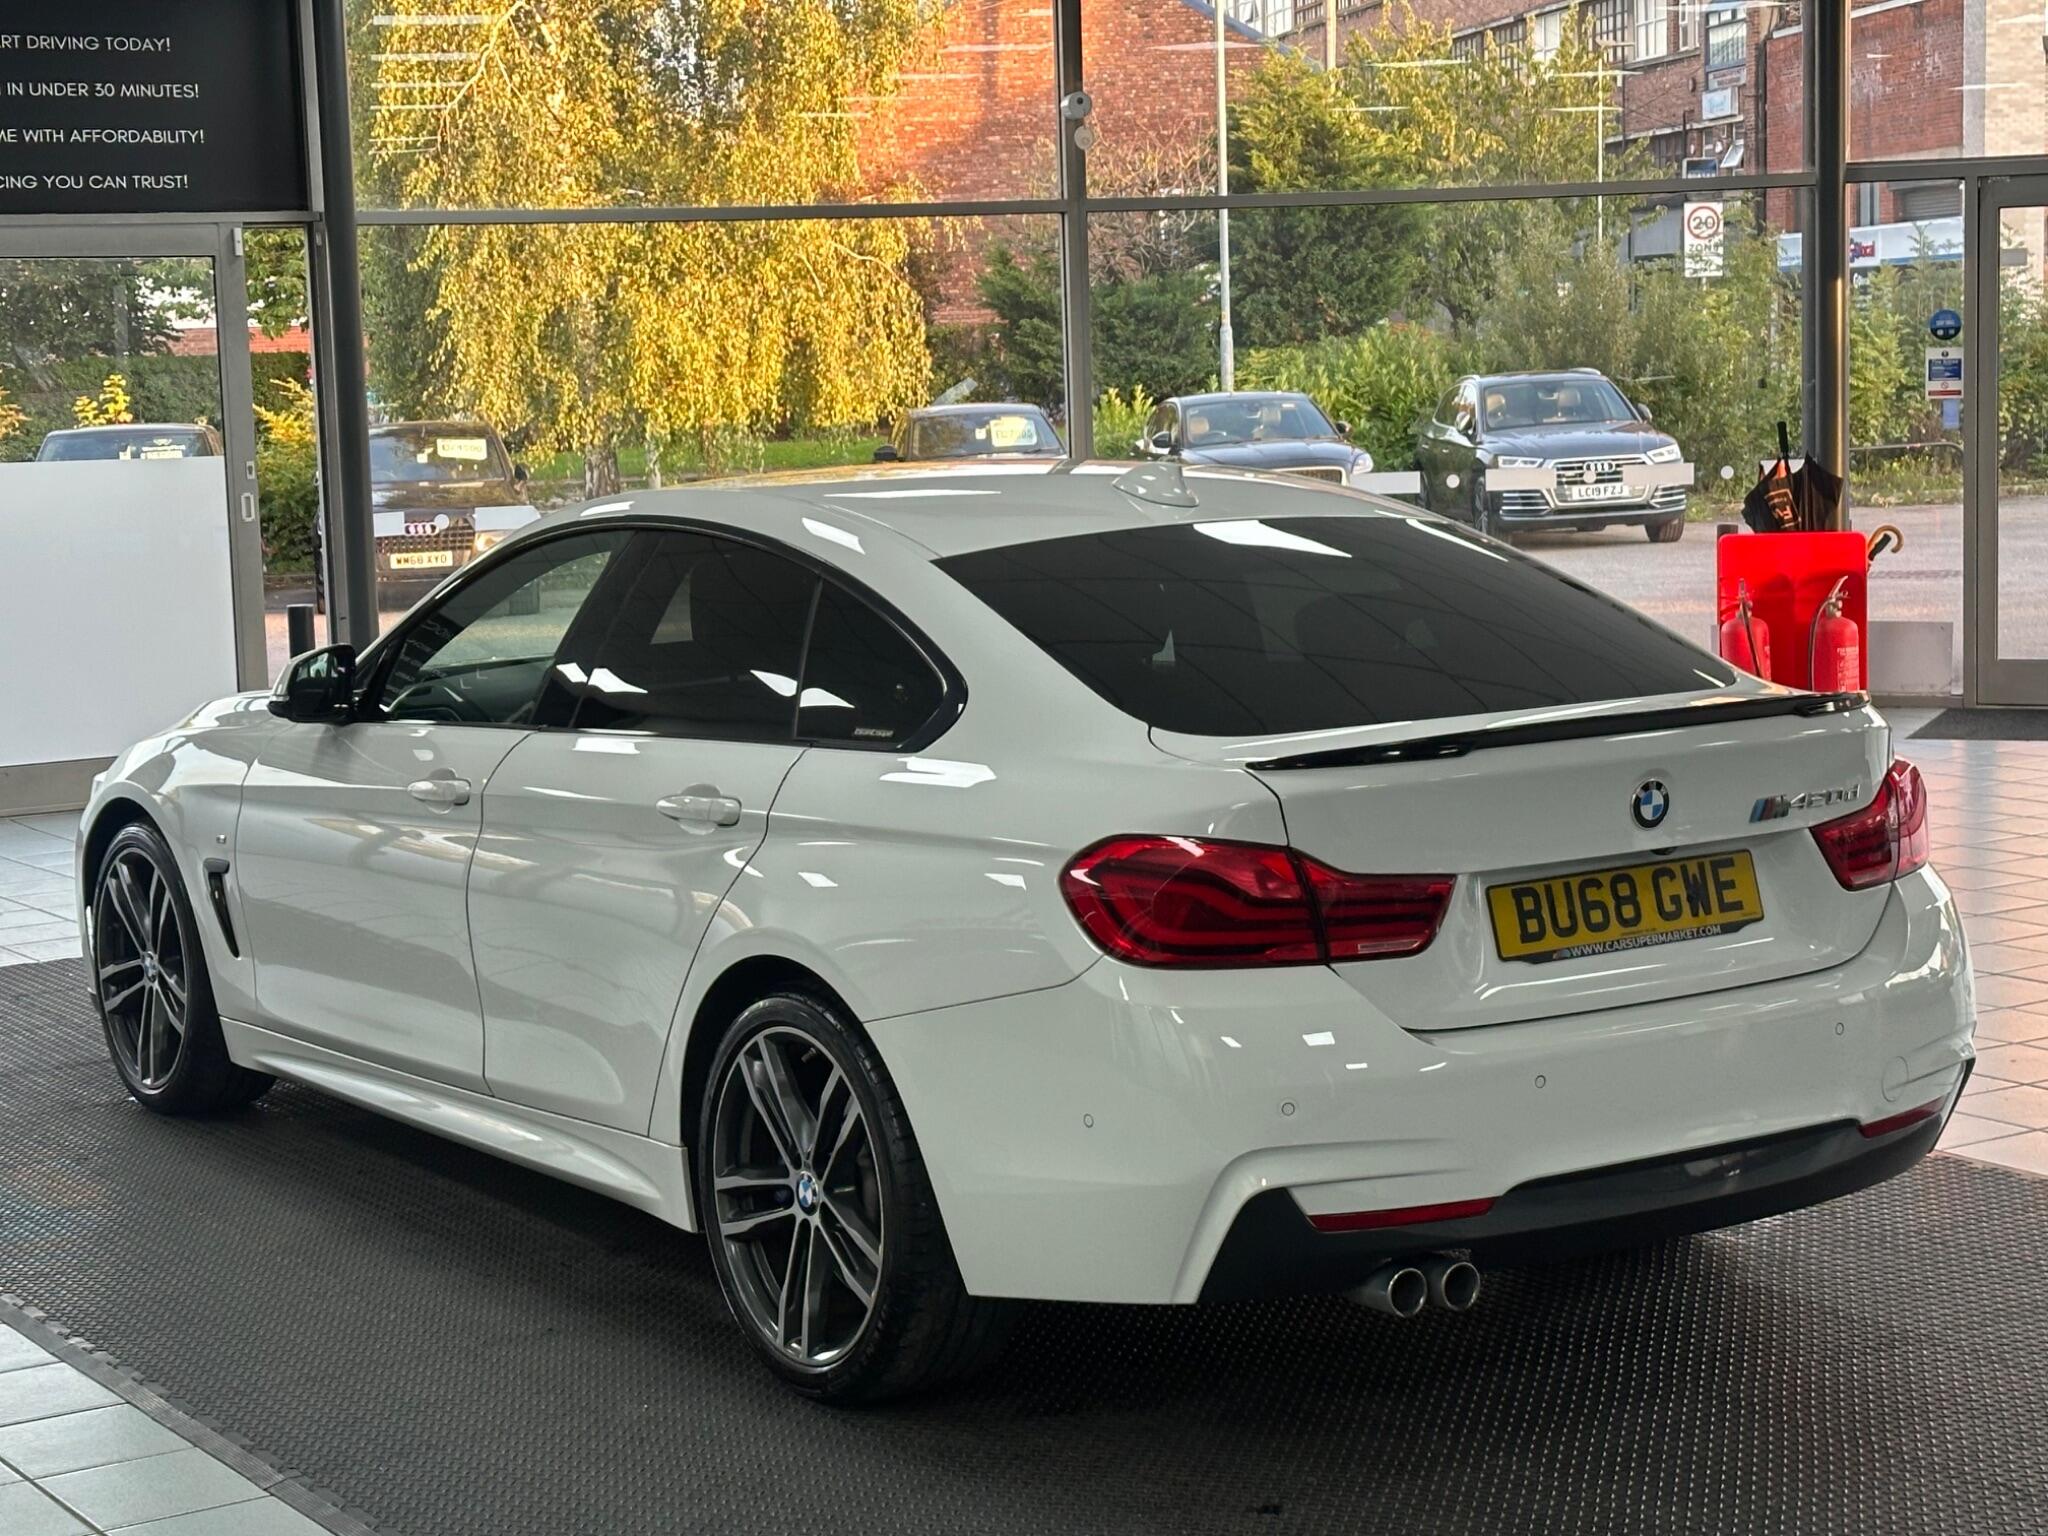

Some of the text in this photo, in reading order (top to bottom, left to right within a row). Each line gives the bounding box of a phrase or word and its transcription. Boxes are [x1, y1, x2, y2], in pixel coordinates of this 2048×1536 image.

[0, 35, 171, 52] RT DRIVING TODAY!
[7, 82, 199, 99] IN UNDER 30 MINUTES!
[22, 128, 64, 143] WITH
[70, 129, 205, 144] AFFORDABILITY!
[42, 175, 84, 189] YOU
[88, 175, 127, 189] CAN
[132, 174, 189, 189] TRUST!
[1692, 215, 1716, 230] 20
[1511, 857, 1745, 945] BU68 GWE
[1570, 925, 1722, 957] WWW.CARSUPERMARKET.COM
